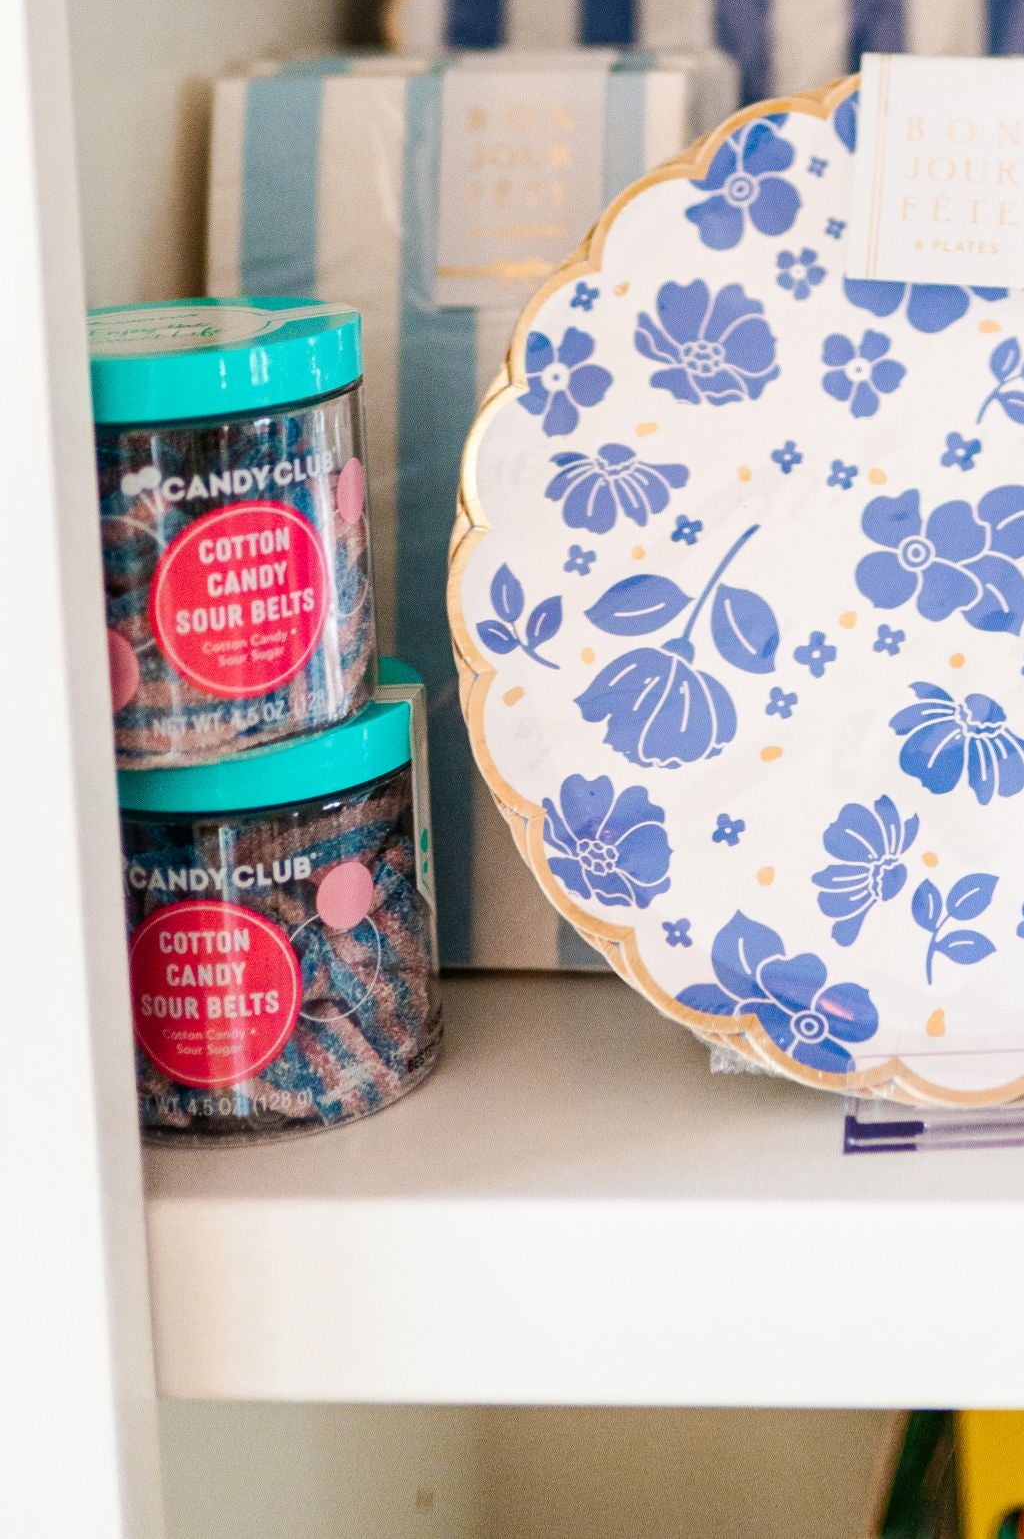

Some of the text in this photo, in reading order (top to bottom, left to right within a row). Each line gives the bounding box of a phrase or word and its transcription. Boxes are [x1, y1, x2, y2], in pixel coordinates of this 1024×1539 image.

[905, 115, 1022, 147] BON
[902, 155, 1019, 187] JOUR
[931, 239, 1000, 255] PLATES
[162, 450, 334, 502] CANDY CLUB
[199, 526, 290, 564] COTTON
[207, 560, 287, 597] CANDY
[176, 587, 315, 635] SOUR BELTS
[129, 855, 312, 891] CANDY CLUB
[159, 928, 250, 955] COTTON
[166, 962, 246, 988] CANDY
[140, 990, 280, 1020] SOUR BELTS
[187, 1098, 214, 1117] 4.5
[253, 1091, 292, 1117] (128
